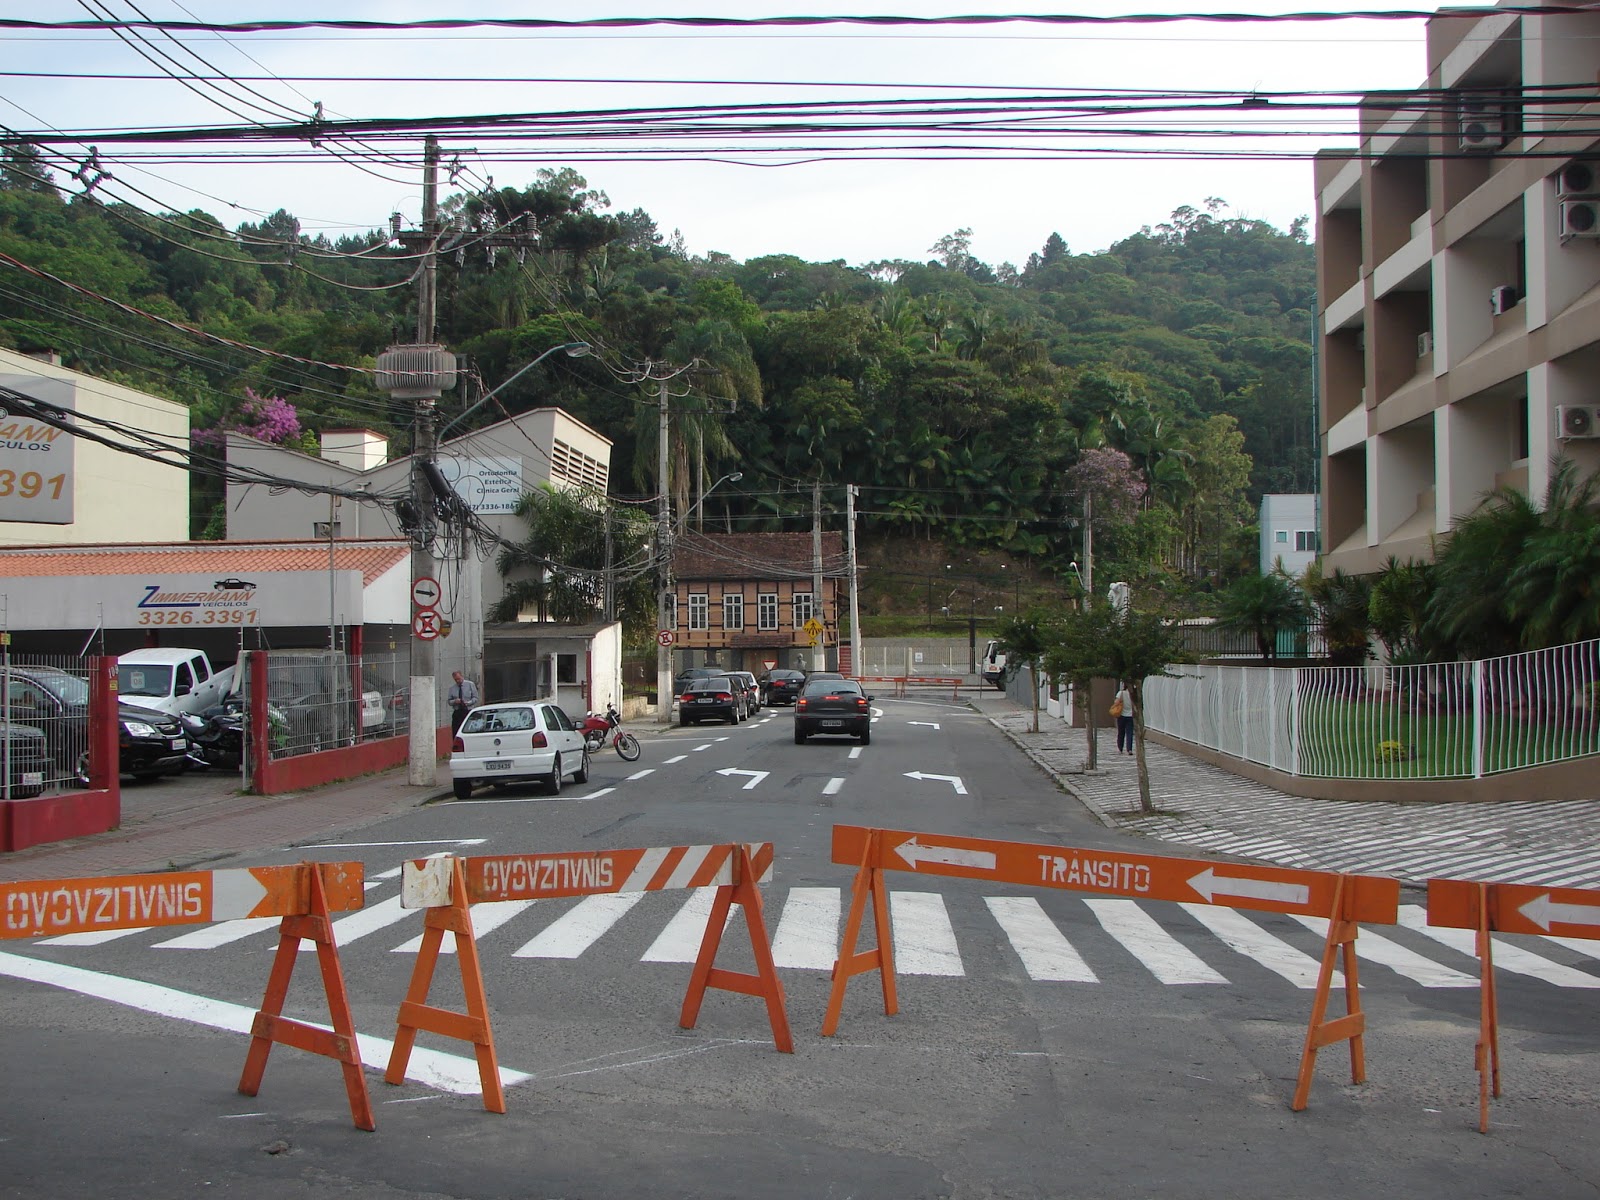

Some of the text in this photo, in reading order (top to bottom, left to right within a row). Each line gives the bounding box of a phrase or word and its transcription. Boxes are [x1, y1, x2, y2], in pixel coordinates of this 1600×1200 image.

[0, 422, 64, 443] ANN
[137, 586, 256, 608] ZIMMERMANN
[138, 610, 257, 625] 3326.3391
[483, 857, 614, 898] SINALIZAÇÃO
[1038, 850, 1150, 892] TRÂNSITO
[6, 882, 202, 935] SINALIZAÇÃO
